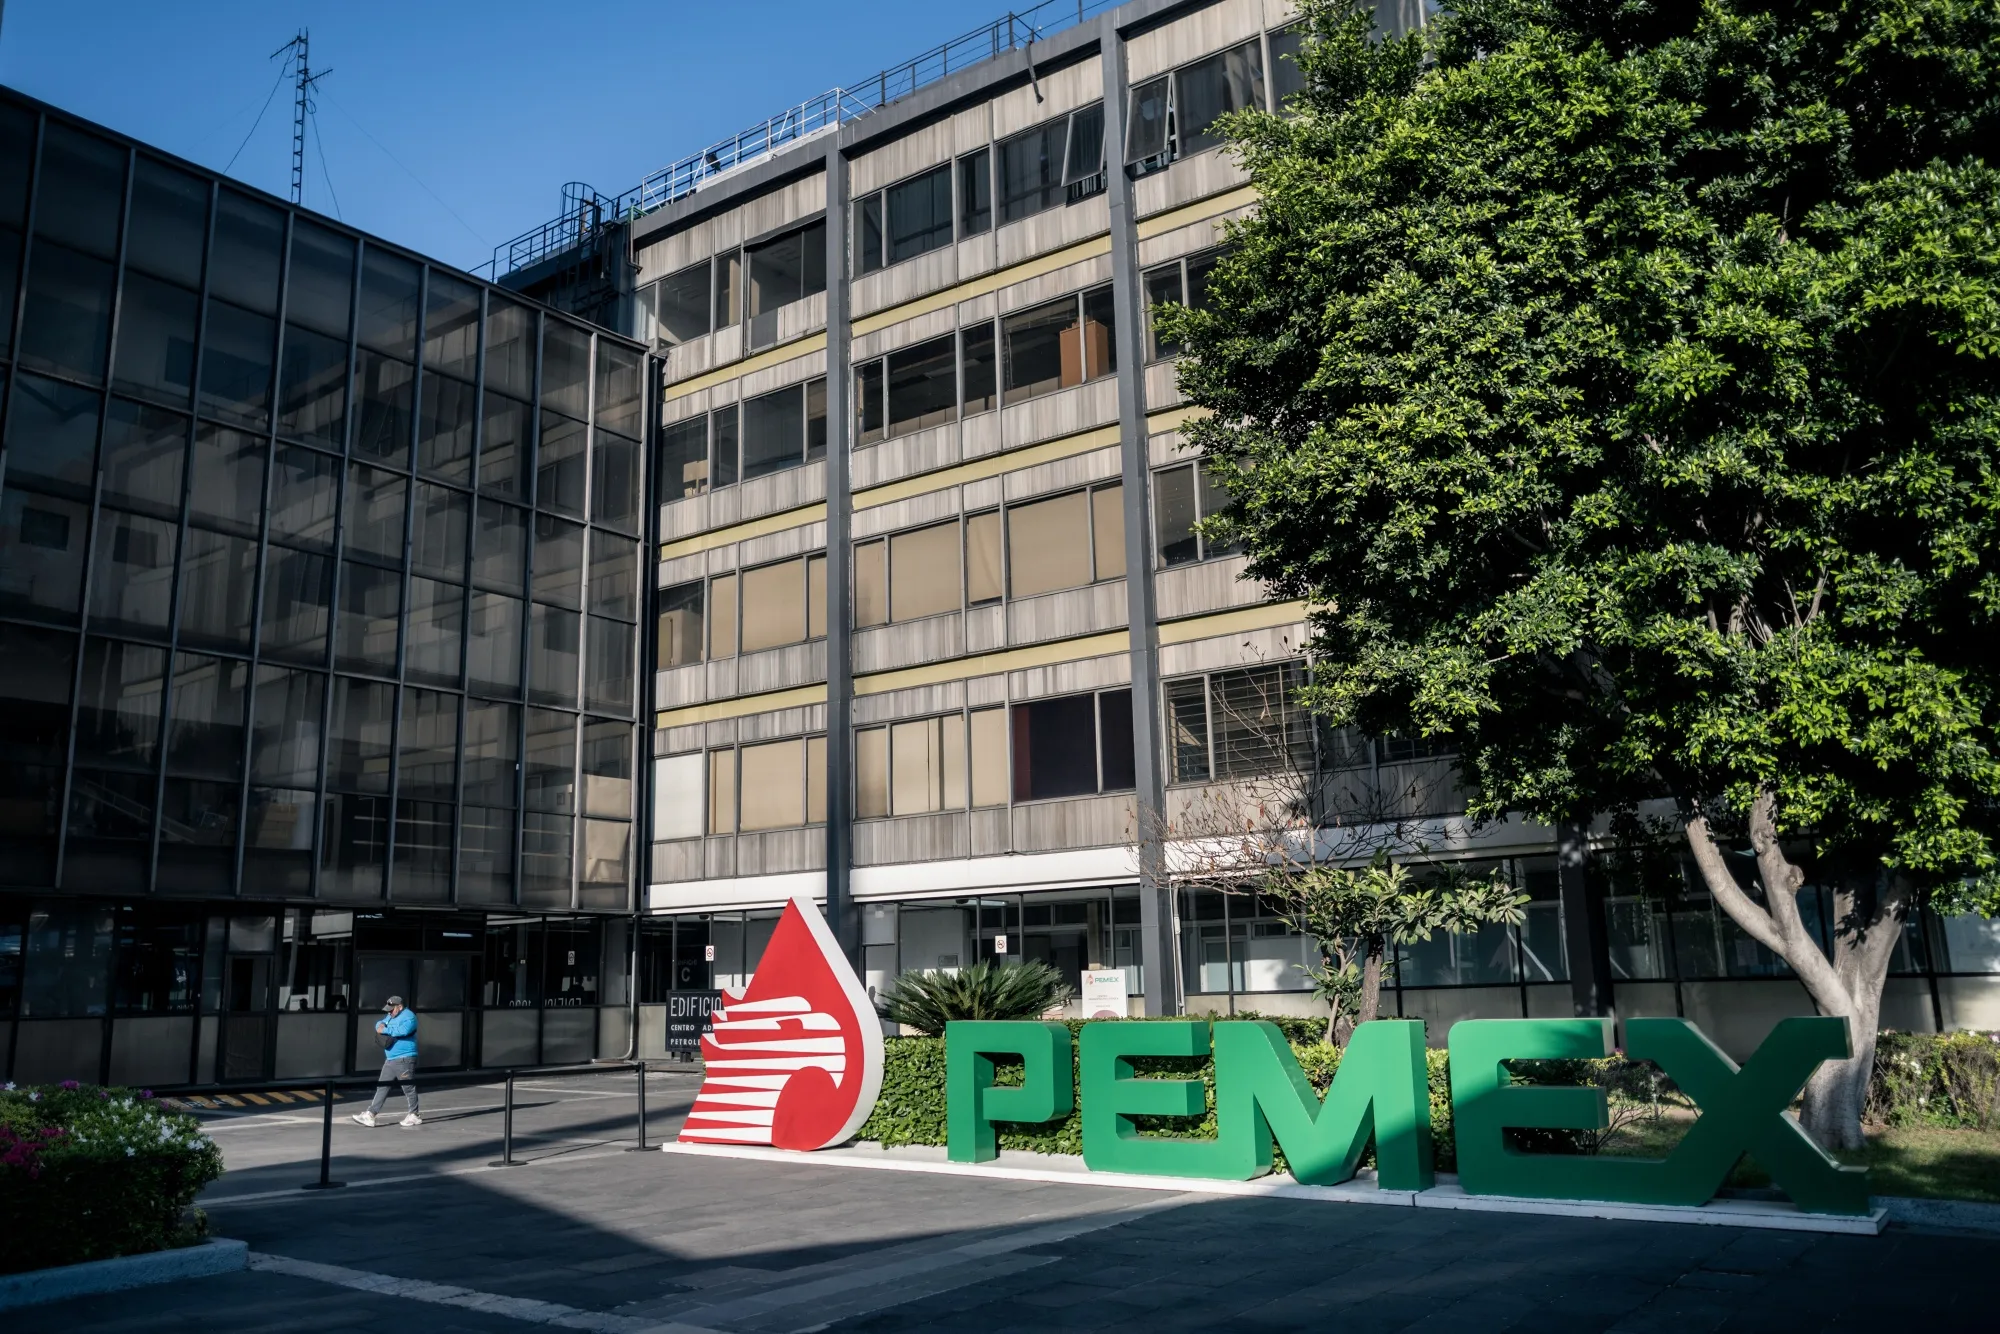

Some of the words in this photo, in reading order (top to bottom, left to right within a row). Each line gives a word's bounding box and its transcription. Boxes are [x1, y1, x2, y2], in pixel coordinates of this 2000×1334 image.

[682, 967, 690, 982] C
[670, 997, 722, 1016] EDIFICIO
[946, 1017, 1870, 1215] PEMEX
